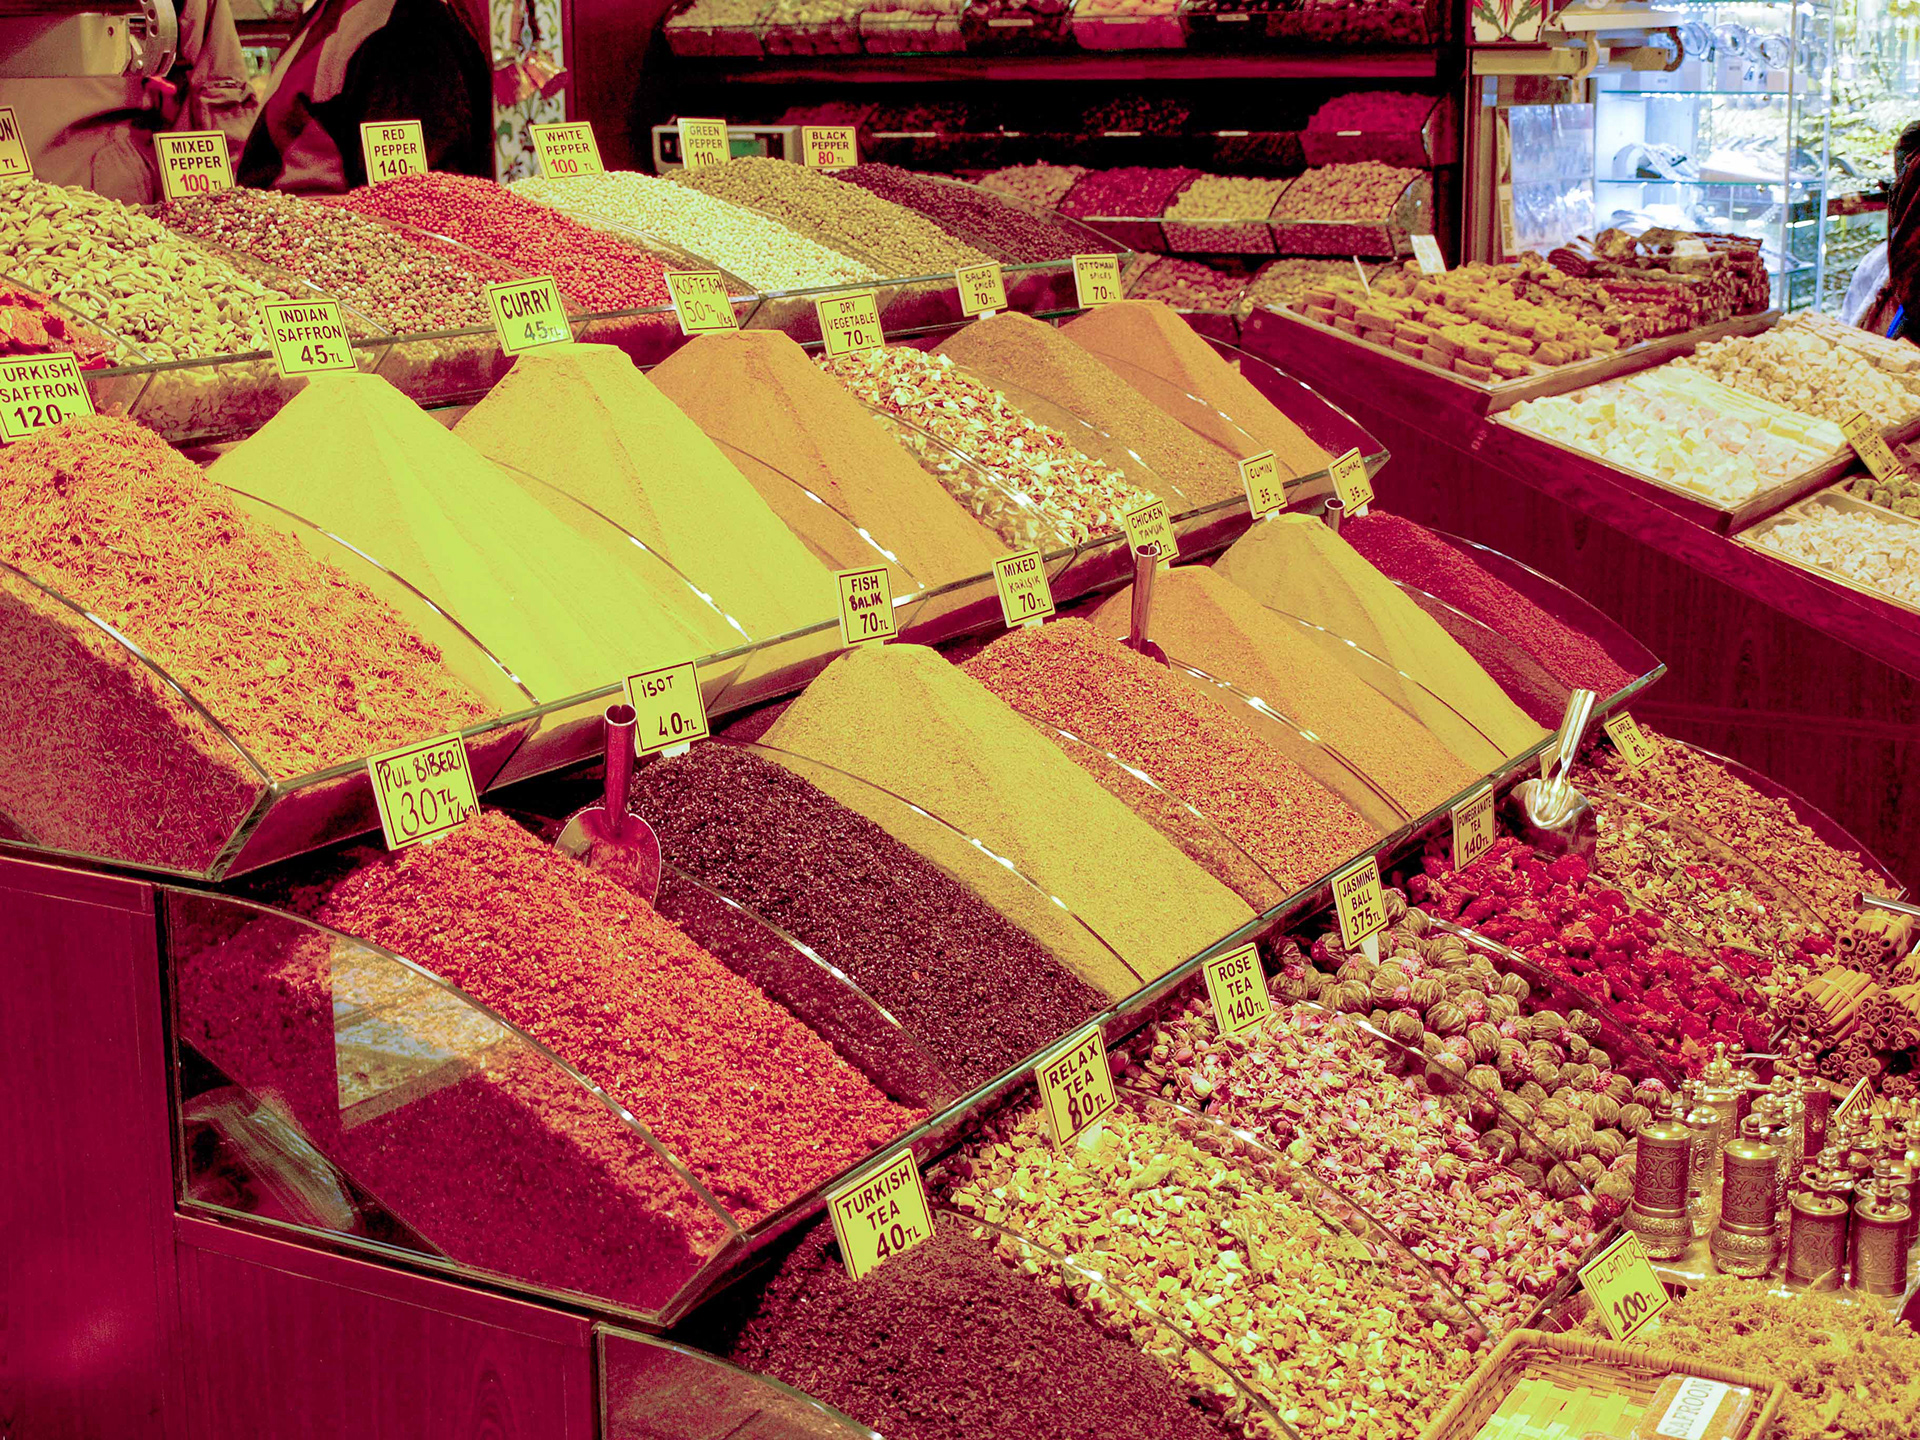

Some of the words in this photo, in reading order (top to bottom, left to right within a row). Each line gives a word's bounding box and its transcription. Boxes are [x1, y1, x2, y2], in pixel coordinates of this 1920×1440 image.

[382, 129, 405, 140] RED
[546, 130, 583, 142] WHITE
[690, 125, 719, 136] GREEN
[812, 131, 847, 140] BLACK
[171, 140, 214, 154] MIXED
[374, 143, 417, 157] PEPPER
[546, 143, 590, 155] PEPPER
[690, 138, 723, 149] PEPPER
[812, 141, 849, 150] PEPPER
[170, 156, 222, 170] PEPPER
[551, 159, 579, 173] 100
[818, 151, 834, 165] 80
[180, 174, 209, 192] 100
[965, 270, 992, 282] SALAD
[974, 279, 996, 291] SPICES
[500, 288, 551, 319] CURRY
[839, 301, 856, 314] DRY
[279, 308, 328, 324] INDIAN
[827, 312, 875, 330] VEGETABLE
[277, 325, 342, 342] SAFFRON
[2, 363, 74, 382] URKISH
[0, 382, 80, 403] SAFFRON
[1250, 462, 1272, 479] CUMIN
[1131, 506, 1163, 528] CHICKEN
[1138, 522, 1164, 540] TAVUK
[1003, 558, 1036, 577] MIXED
[851, 575, 879, 592] FISH
[849, 591, 883, 611] BALIK
[1615, 720, 1632, 734] APPLE
[1624, 733, 1636, 743] TEA
[378, 762, 411, 792] PUL
[1459, 796, 1491, 827] POMEGRANATE
[1471, 818, 1481, 833] TEA
[1342, 867, 1375, 898] JASMINE
[1351, 889, 1372, 911] BALL
[1218, 956, 1251, 981] ROSE
[1227, 977, 1253, 997] TEA
[1049, 1041, 1098, 1089] RELAX
[1063, 1069, 1094, 1100] TEA
[842, 1165, 911, 1219] TURKISH
[866, 1200, 900, 1230] TEA
